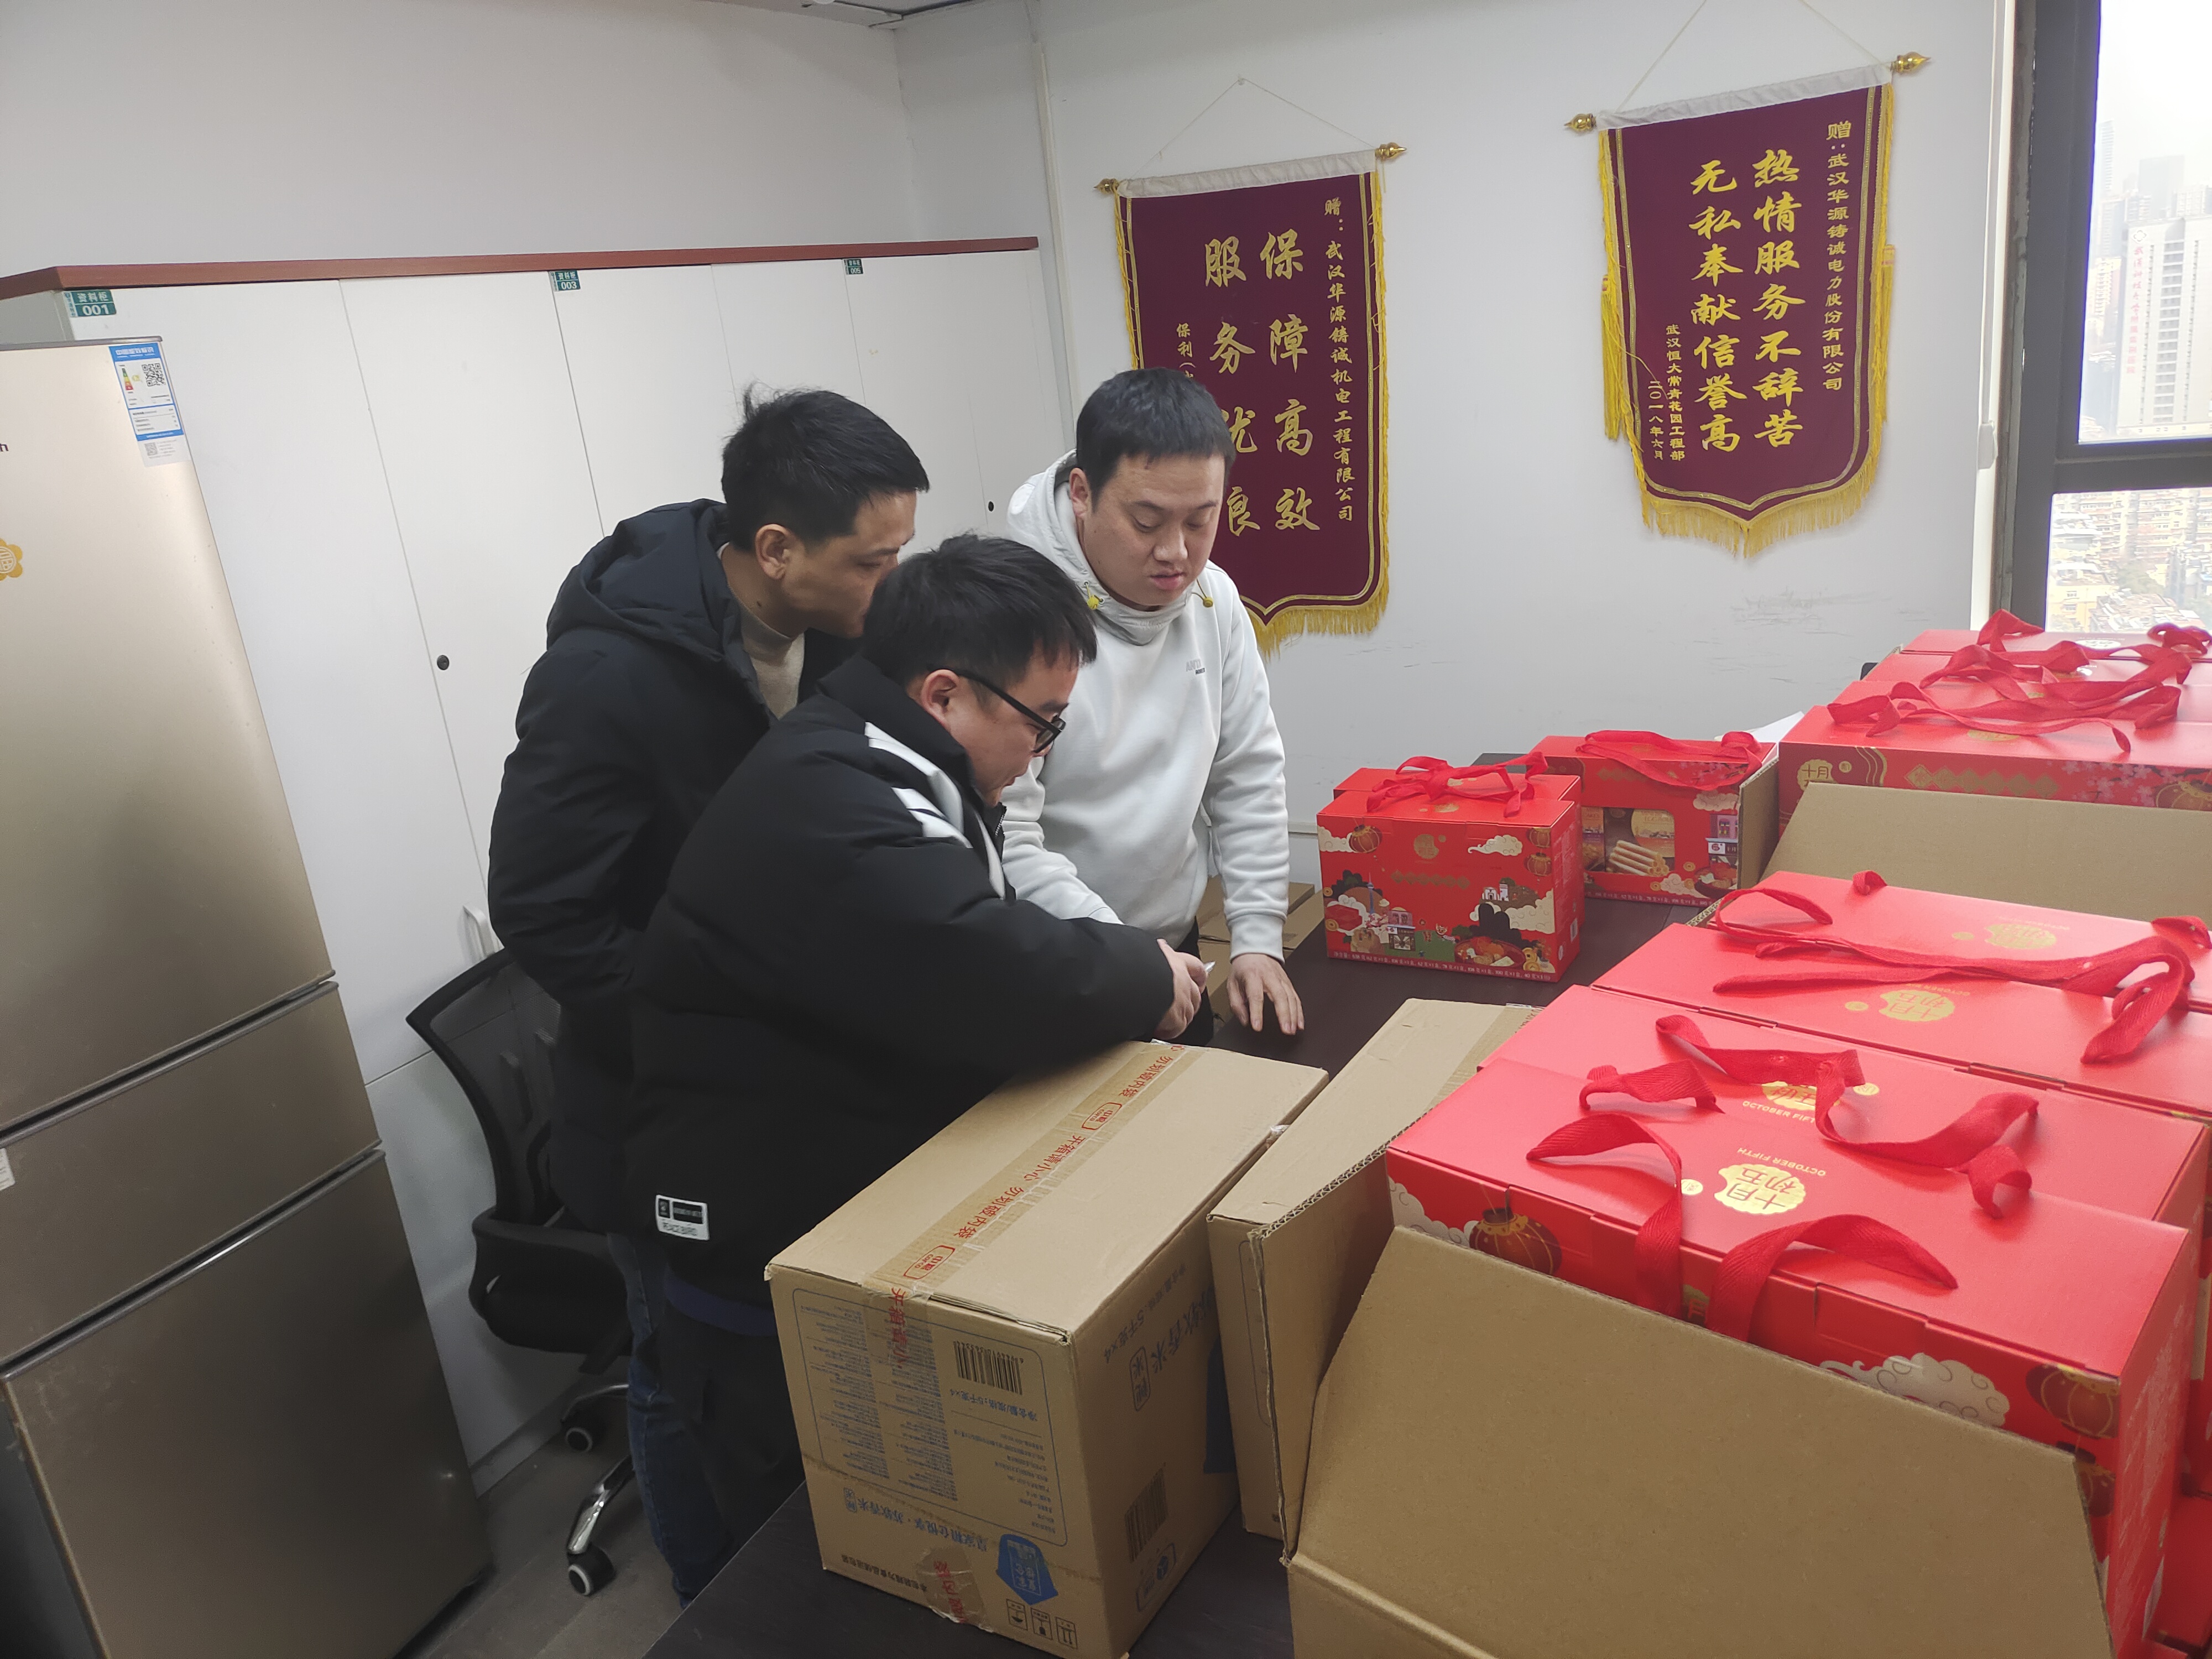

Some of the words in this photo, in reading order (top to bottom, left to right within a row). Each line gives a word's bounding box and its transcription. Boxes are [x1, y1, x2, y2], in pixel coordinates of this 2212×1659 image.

[77, 291, 109, 302] 资料柜
[560, 281, 577, 290] 003
[1752, 149, 1806, 448] 热情服务不辞苦
[82, 304, 109, 316] 001
[1688, 159, 1747, 453] 无私奉献信誉高
[1259, 228, 1321, 531] 保障高效
[1666, 324, 1686, 461] 武汉恒大常青花园工程部
[1743, 1100, 1791, 1117] OCTOBER
[1792, 1113, 1816, 1124] FIFT
[1024, 1134, 1086, 1181] 开箱请小心
[1736, 1147, 1771, 1162] FIFTH
[1772, 1157, 1826, 1176] OCTOBER
[1735, 1167, 1796, 1194] 初五
[1726, 1183, 1786, 1210] 十月
[953, 1186, 1024, 1239] 勿划破内袋
